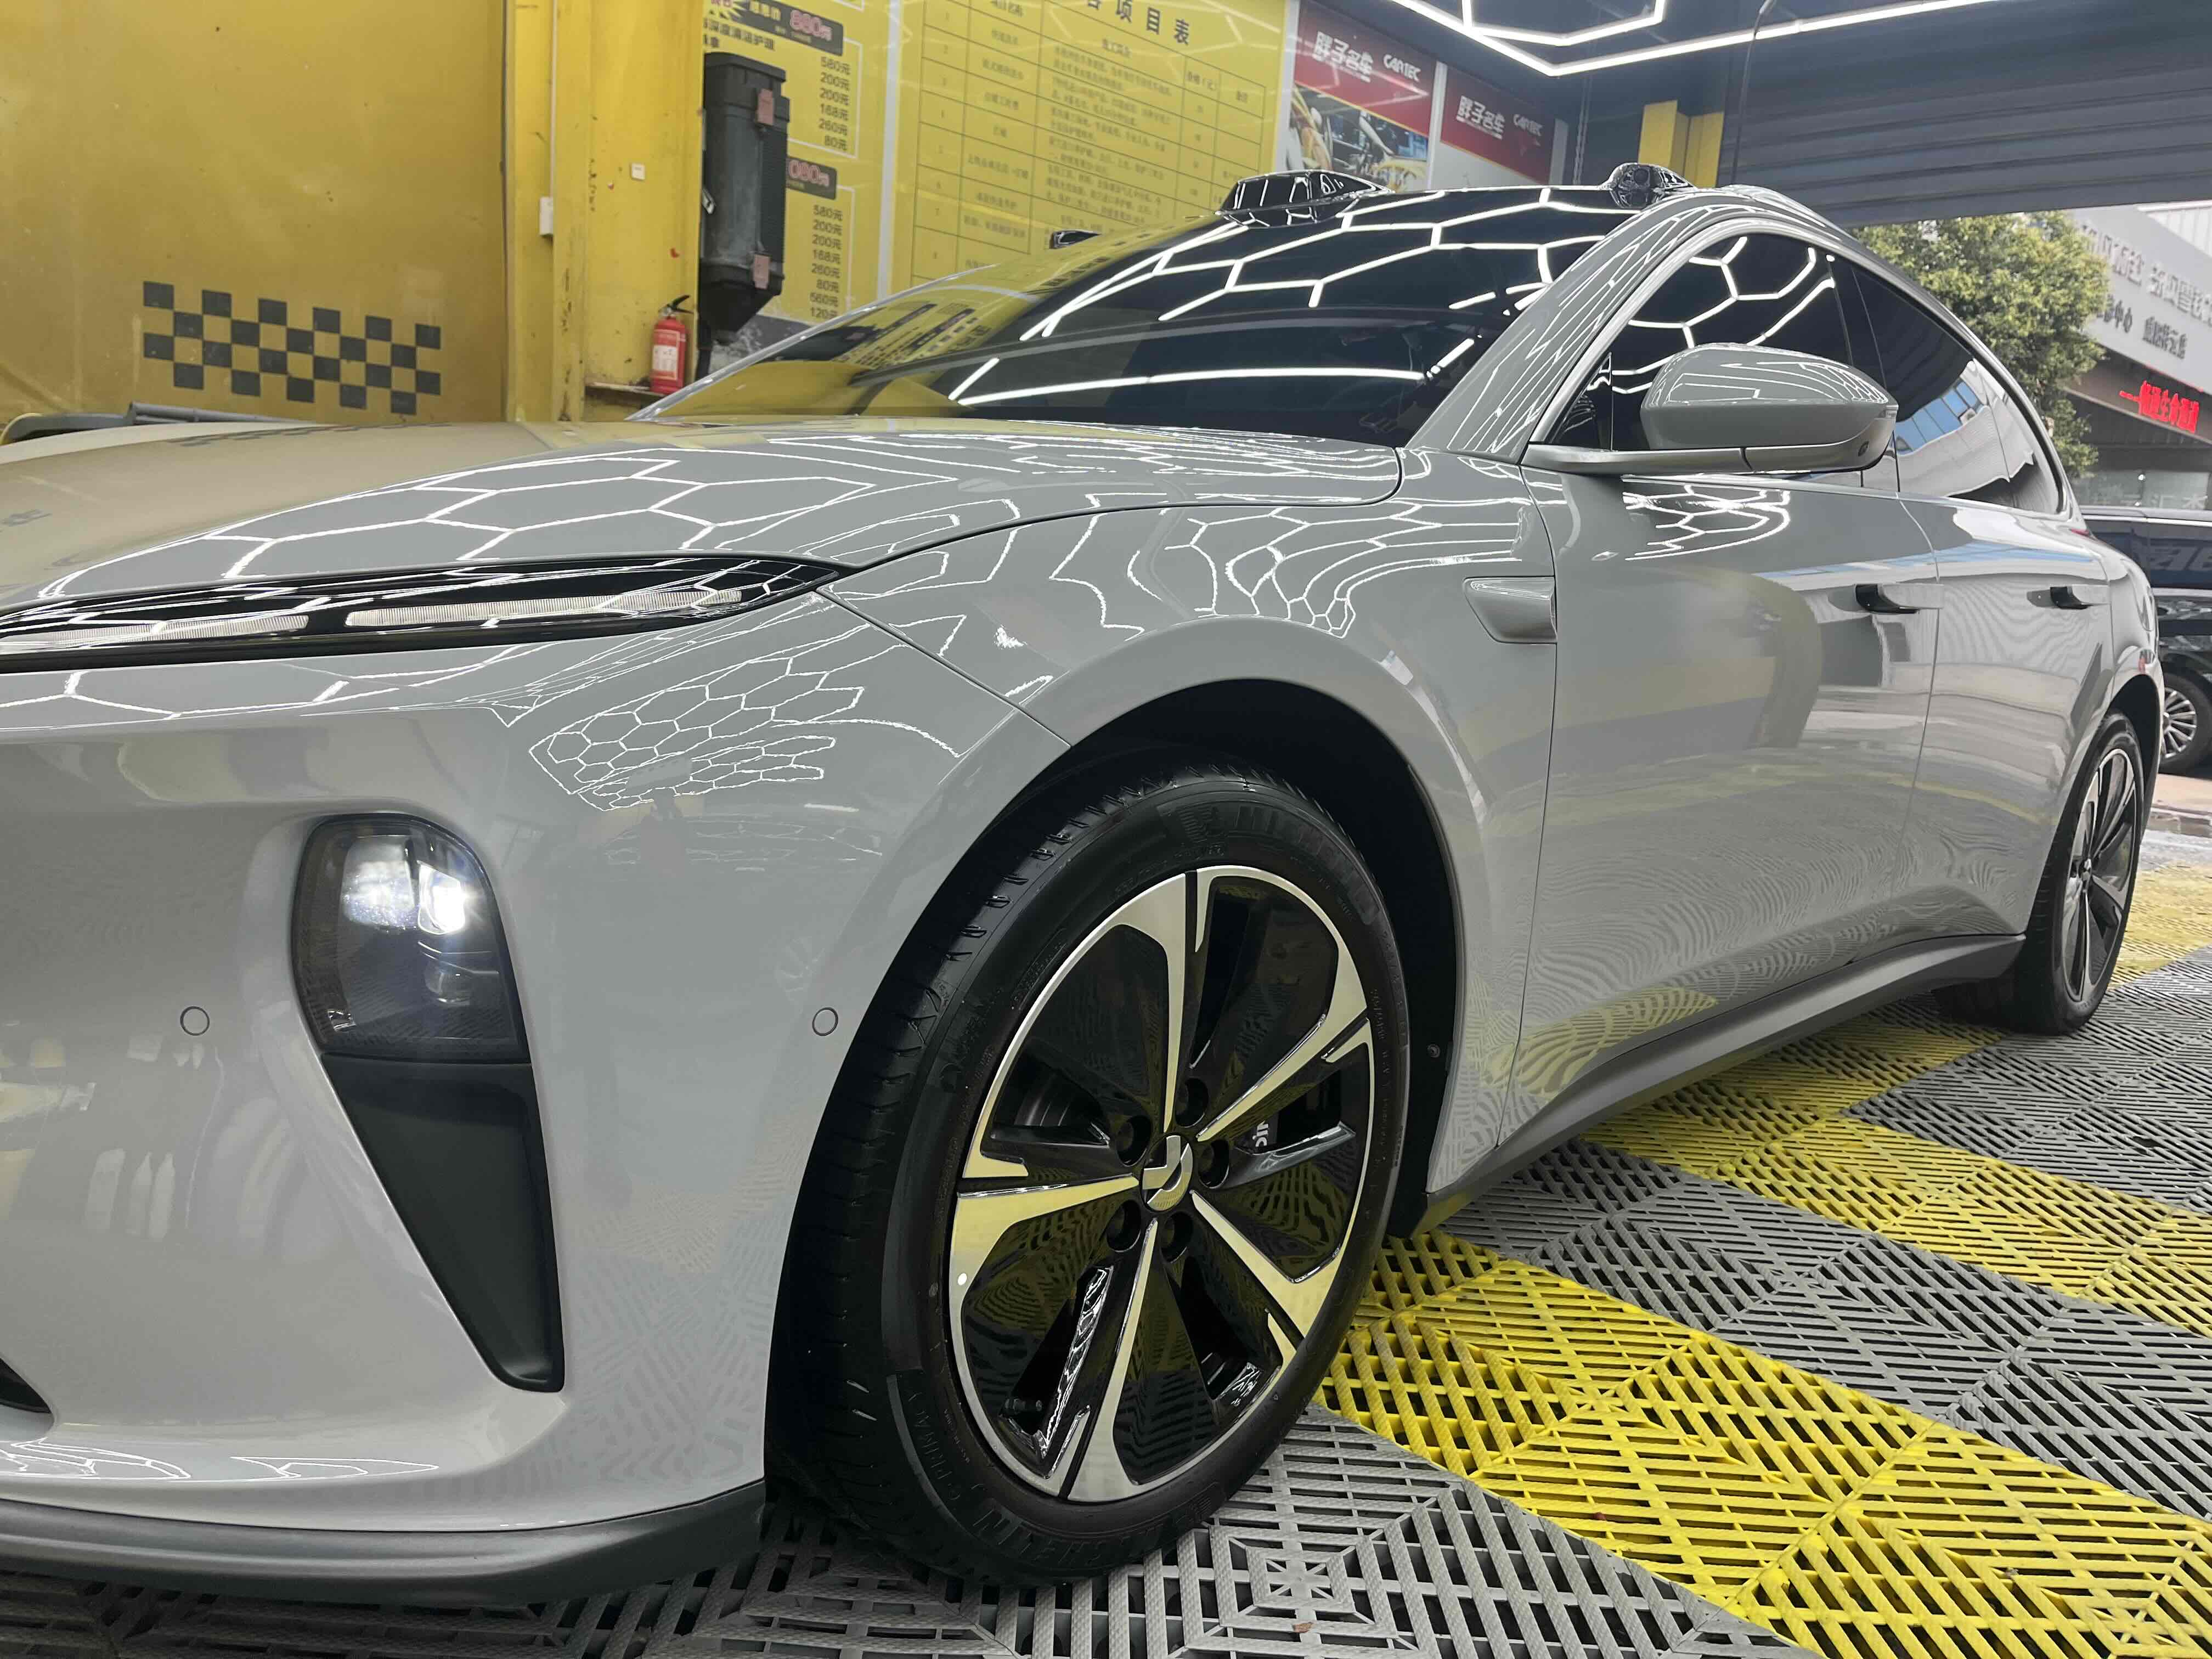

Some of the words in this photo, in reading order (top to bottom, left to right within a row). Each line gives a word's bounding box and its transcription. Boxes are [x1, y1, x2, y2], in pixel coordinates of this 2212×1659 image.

[820, 56, 850, 75] 580元
[820, 71, 850, 91] 200元
[819, 87, 849, 105] 200元
[813, 204, 843, 222] 580元
[812, 219, 842, 236] 200元
[811, 234, 842, 250] 200元
[812, 249, 840, 265] 168元
[816, 279, 839, 294] 80元
